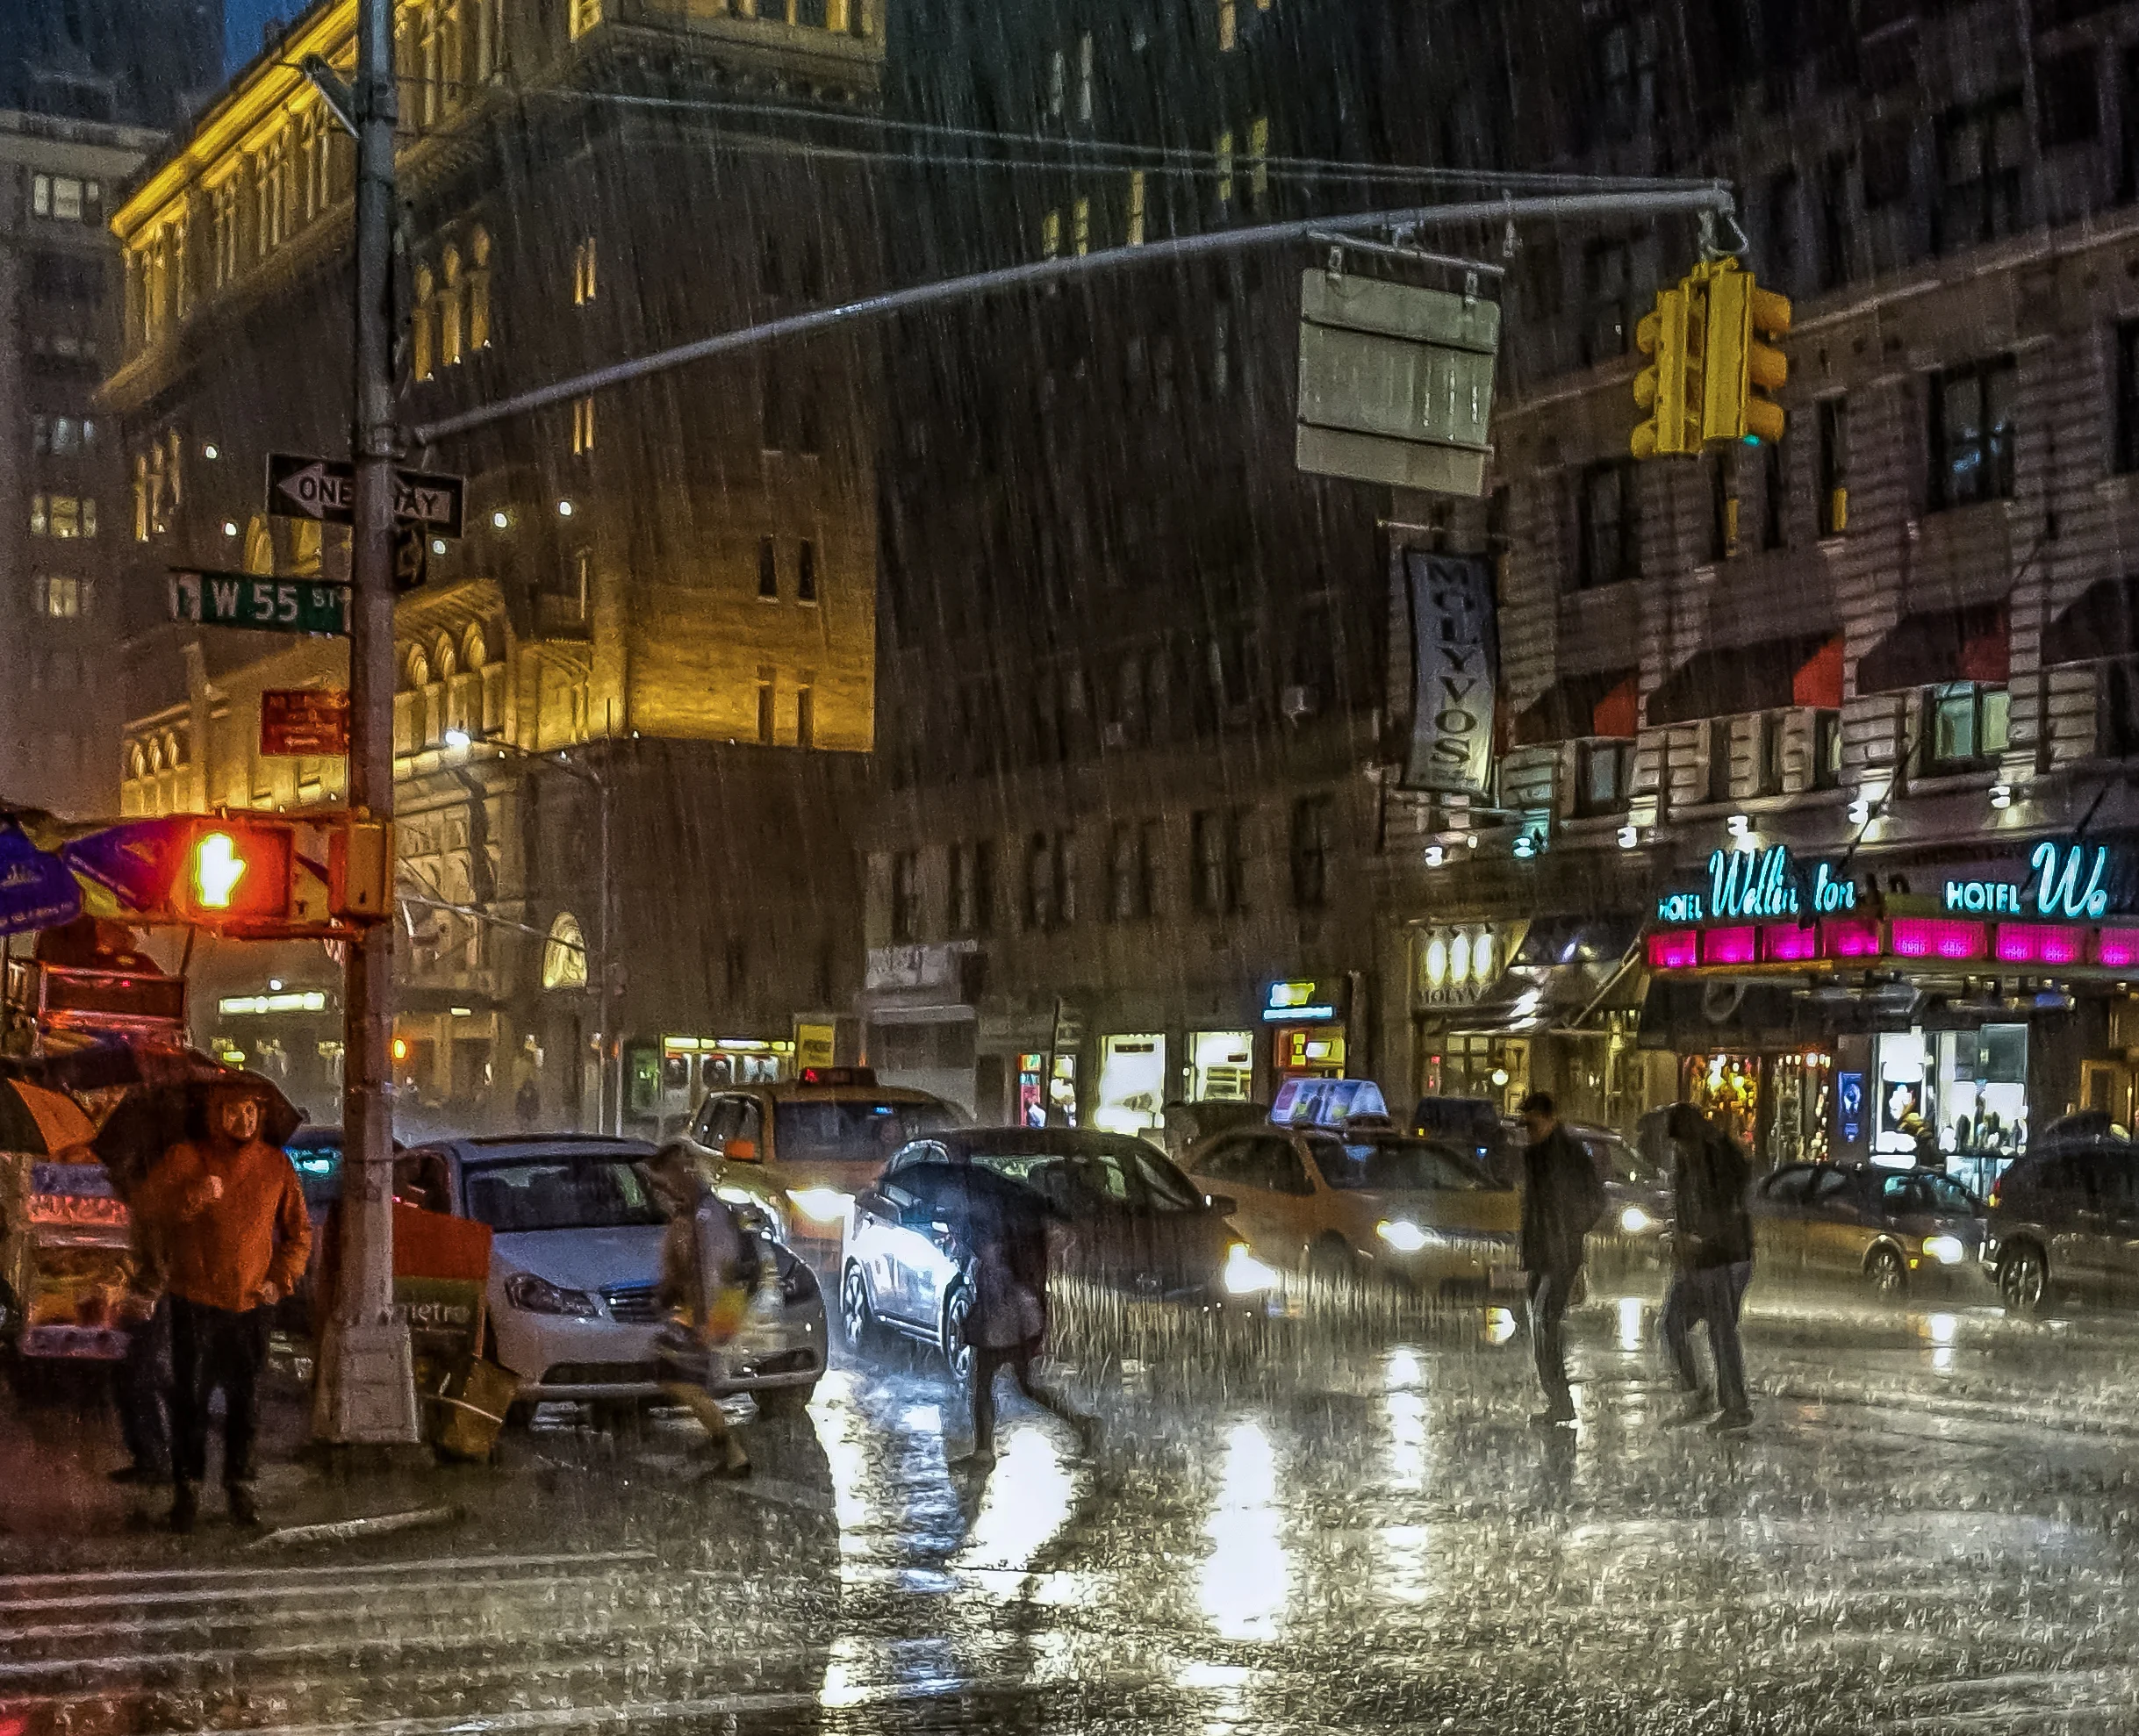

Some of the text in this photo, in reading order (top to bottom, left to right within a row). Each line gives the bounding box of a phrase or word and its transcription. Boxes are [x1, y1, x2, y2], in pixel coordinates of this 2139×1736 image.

[298, 476, 352, 506] ONE
[212, 578, 336, 621] W 55 ST
[1946, 880, 2021, 914] HOTEL
